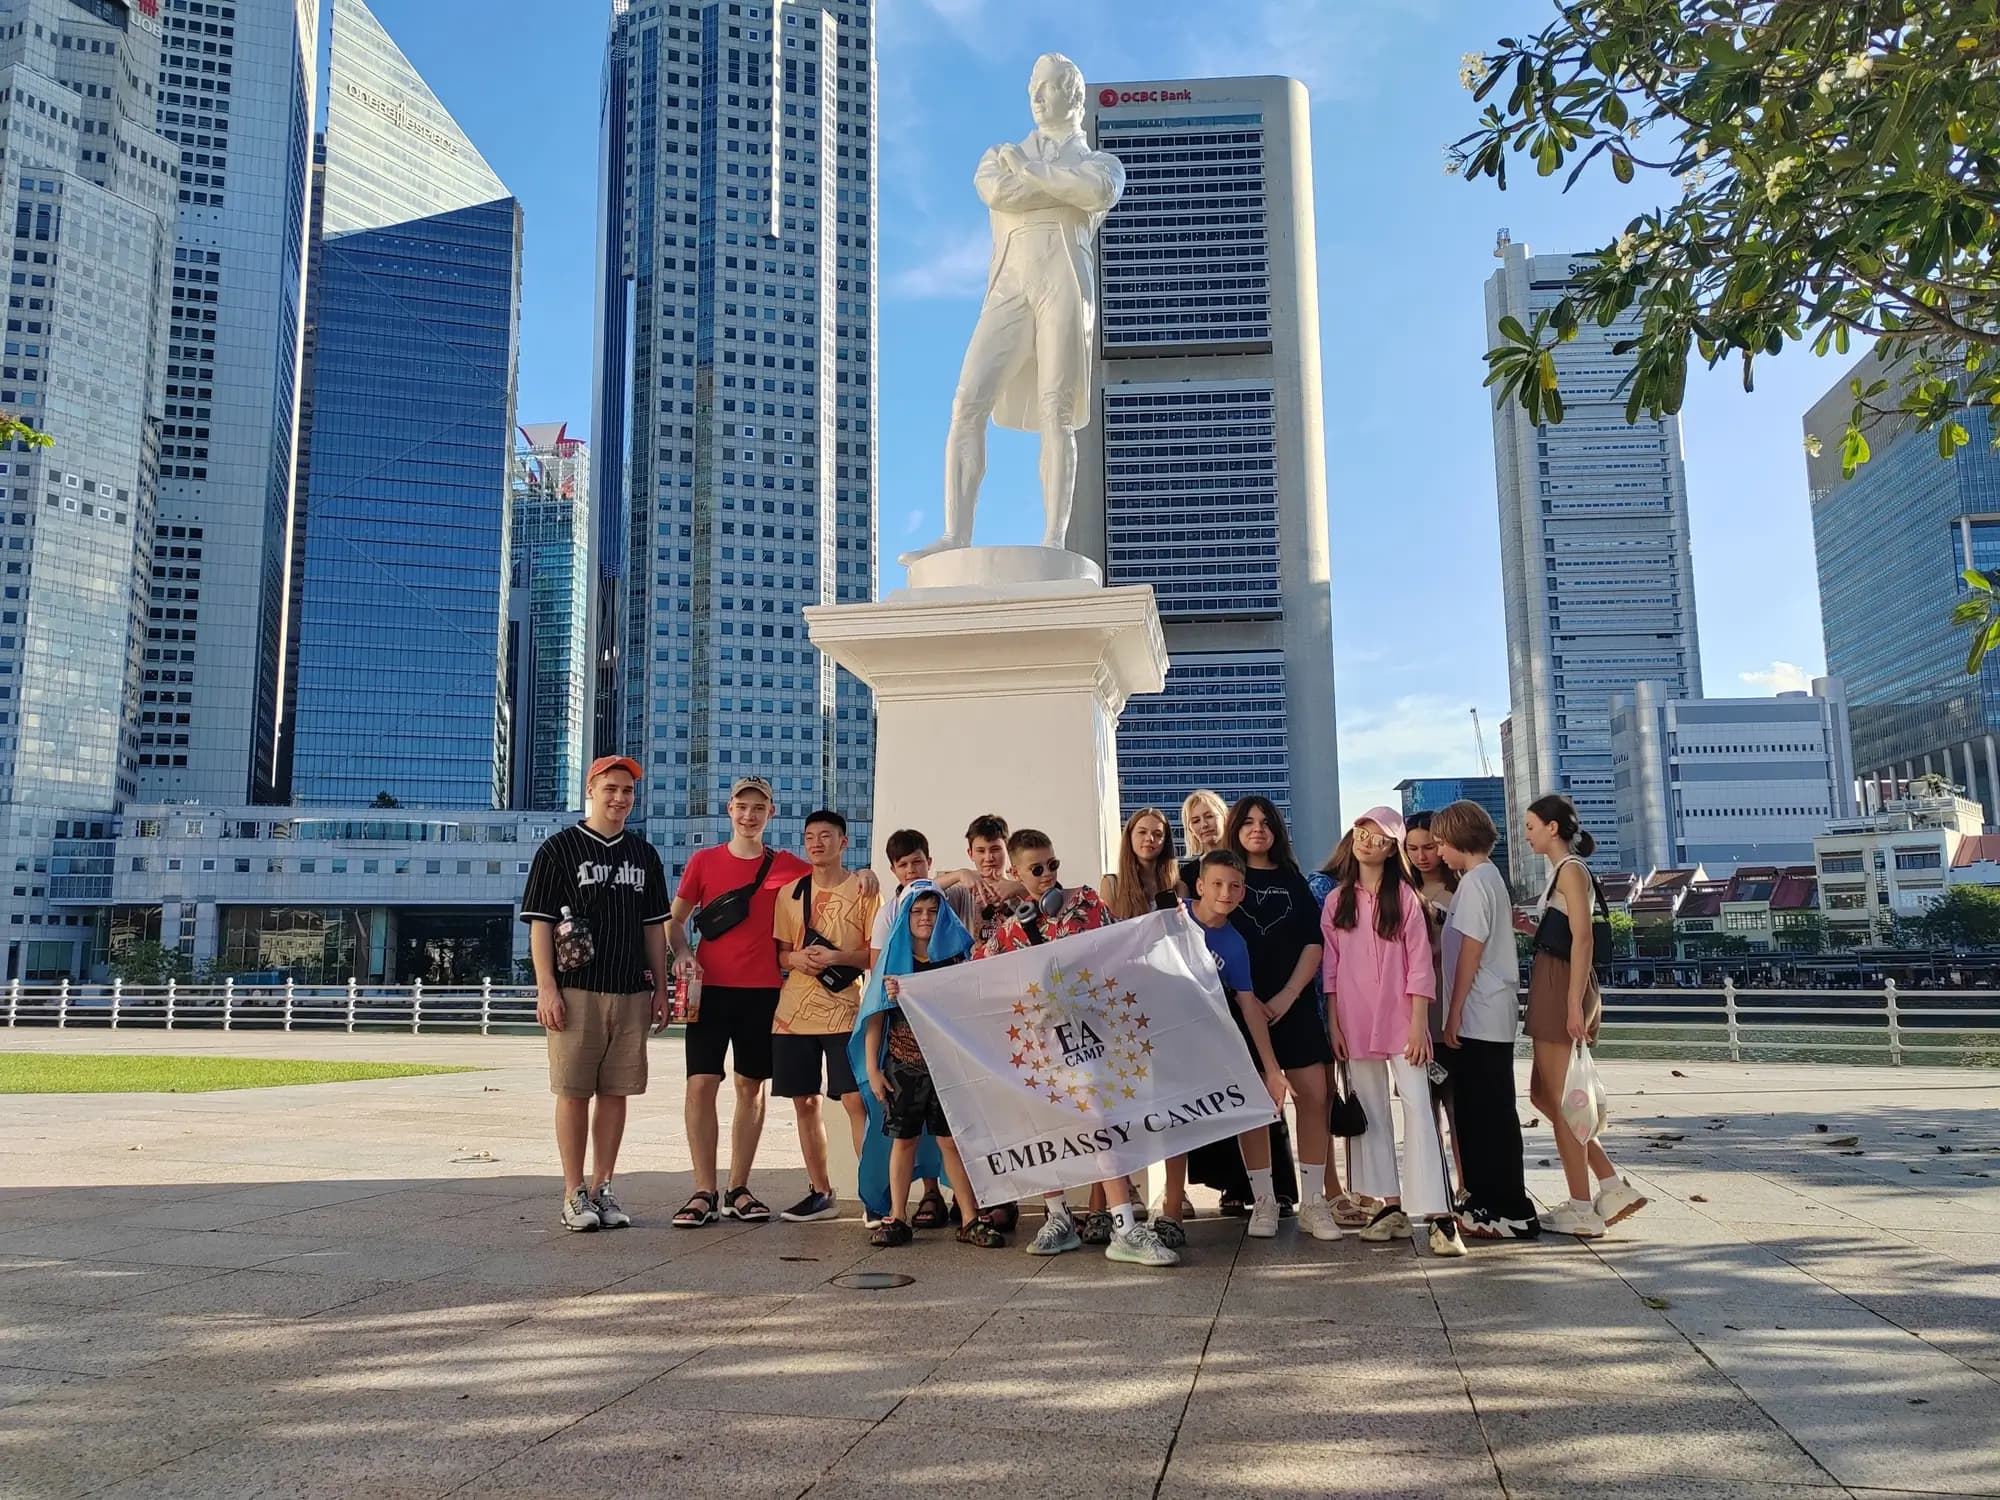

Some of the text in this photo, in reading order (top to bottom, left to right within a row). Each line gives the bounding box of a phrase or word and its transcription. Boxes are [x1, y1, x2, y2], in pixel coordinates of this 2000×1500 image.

[131, 10, 162, 39] UOB
[1120, 88, 1191, 103] OCBC Bank
[1054, 1020, 1104, 1055] EA
[1065, 1045, 1105, 1067] CAMP
[986, 1084, 1246, 1176] EMBASSY CAMPS
